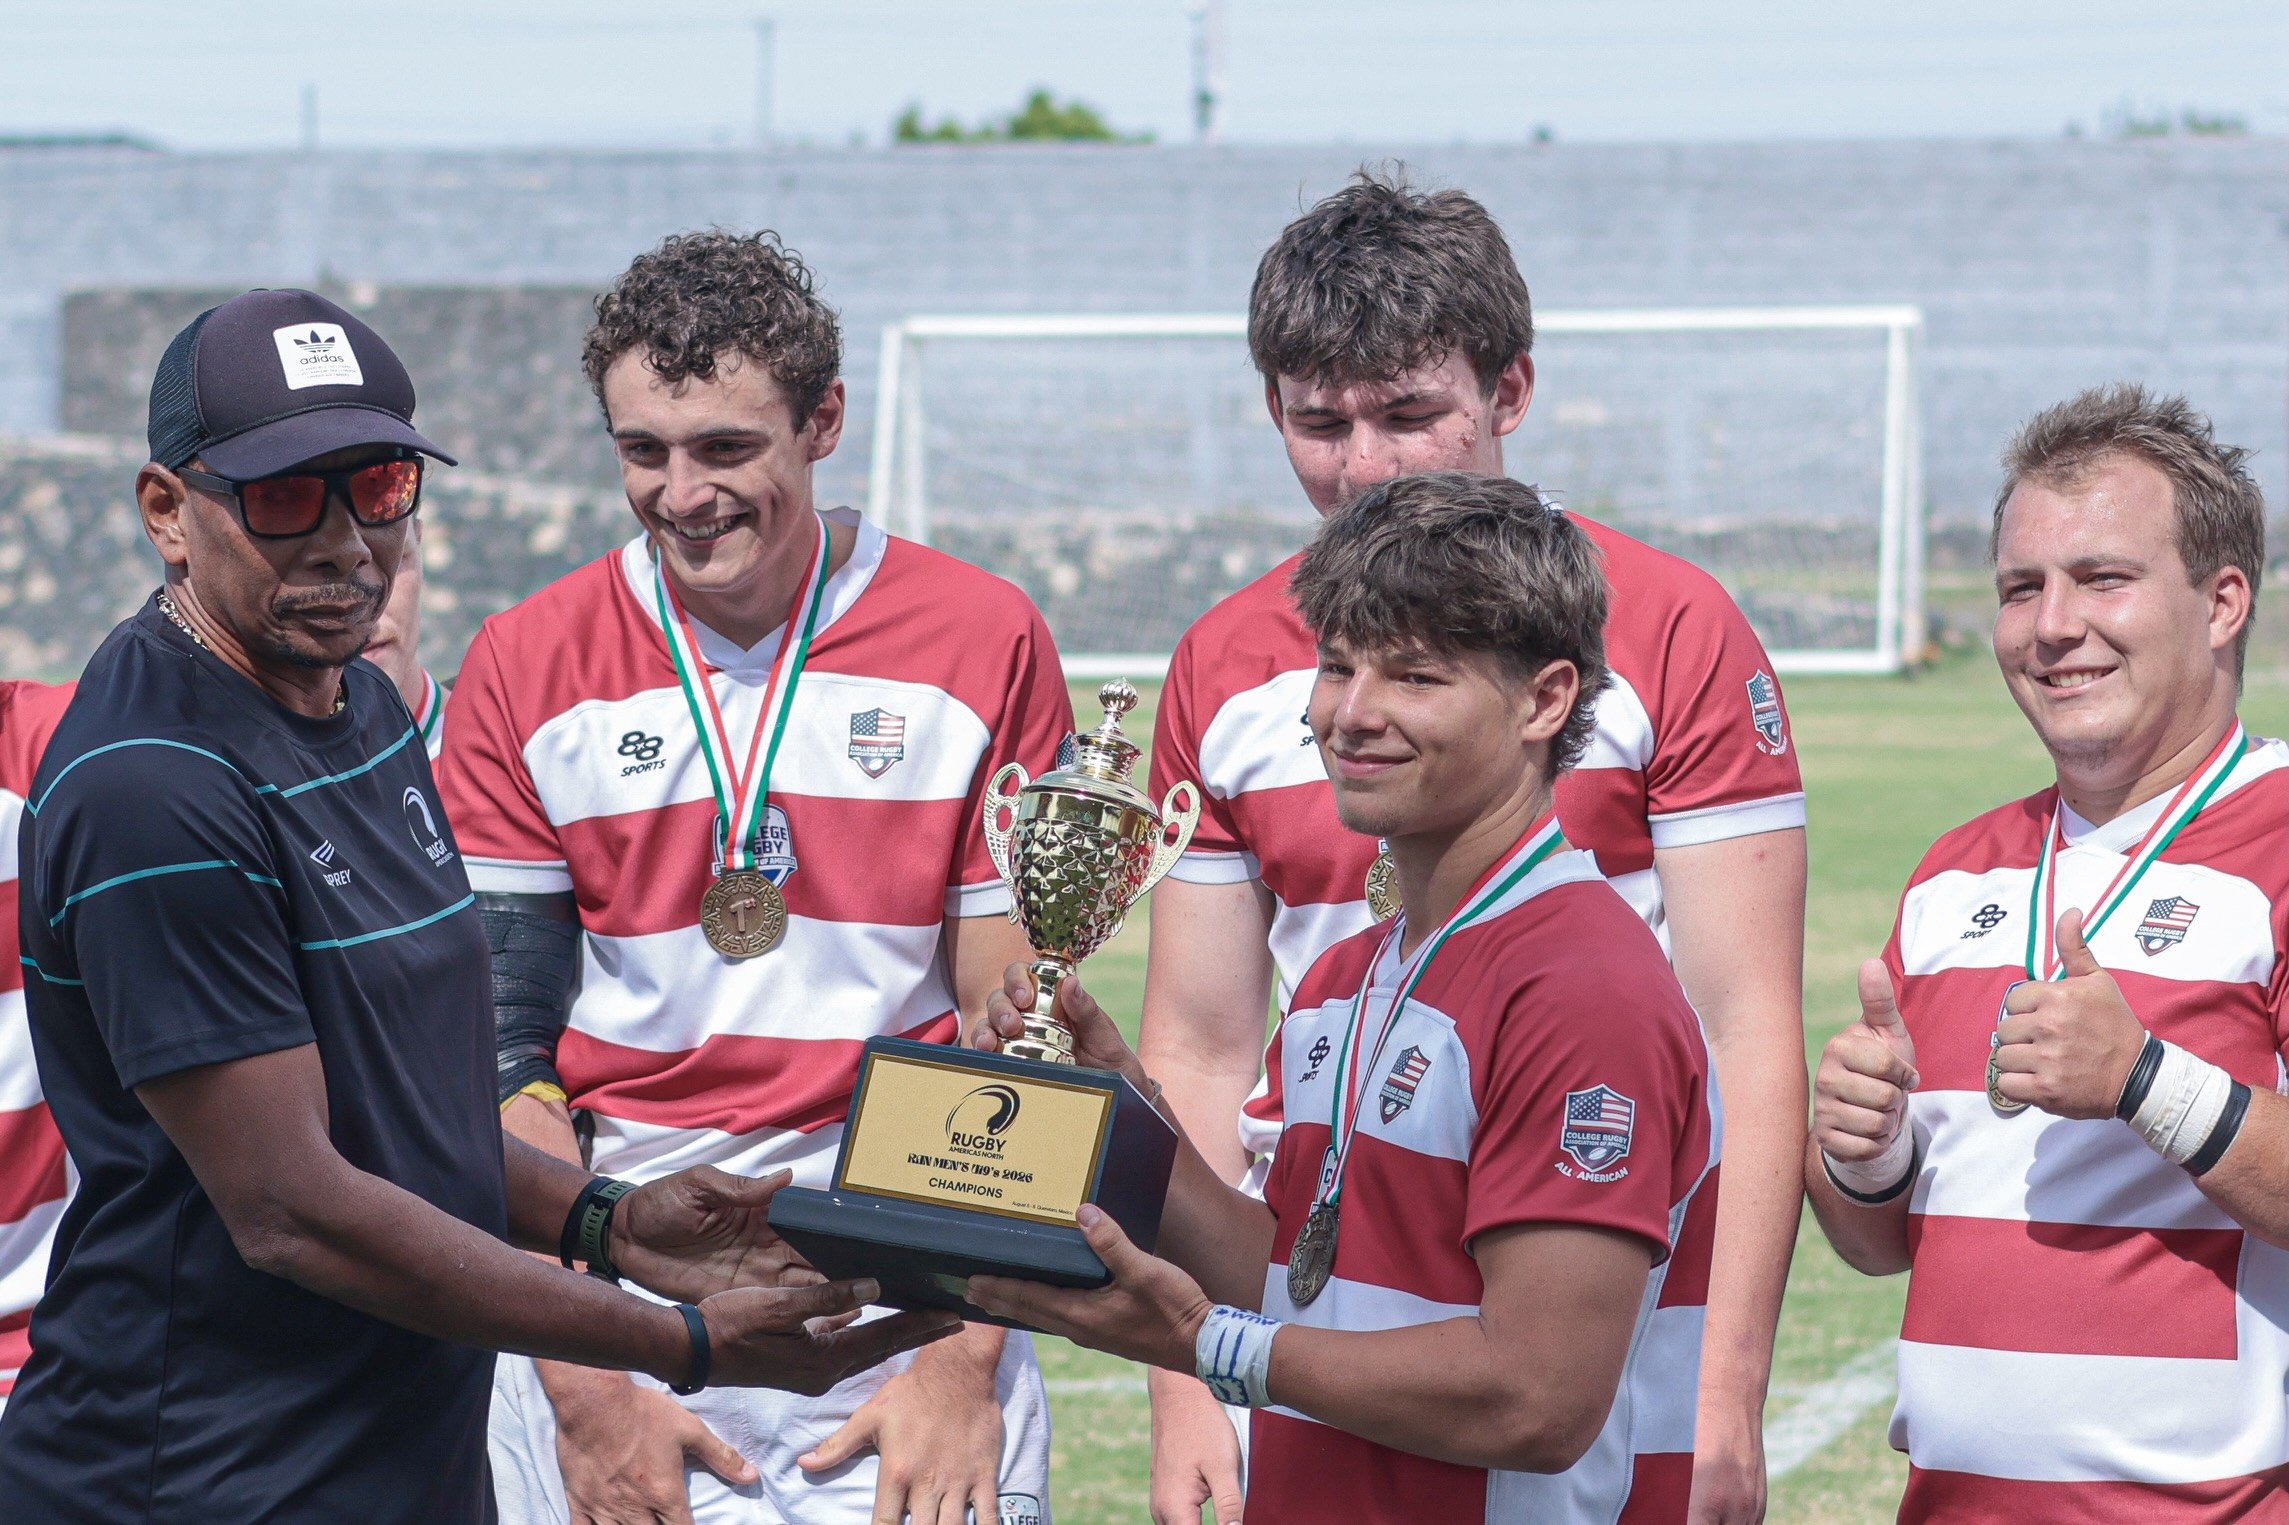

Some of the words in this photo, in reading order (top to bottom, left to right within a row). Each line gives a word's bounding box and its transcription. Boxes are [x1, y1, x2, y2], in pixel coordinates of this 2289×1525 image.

[300, 354, 344, 365] adidas
[620, 759, 667, 777] SPORTS
[754, 840, 783, 856] GBY
[950, 1131, 1007, 1152] RUGBY
[1566, 1132, 1601, 1140] COLLEGE
[1602, 1134, 1628, 1144] RUGBY
[948, 1146, 981, 1157] AMERICAS
[981, 1151, 1004, 1161] NORTH
[1002, 1169, 1033, 1183] 2026
[1554, 1161, 1573, 1177] ALL
[1576, 1166, 1629, 1183] AMERICAN
[928, 1177, 1003, 1199] CHAMPIONS
